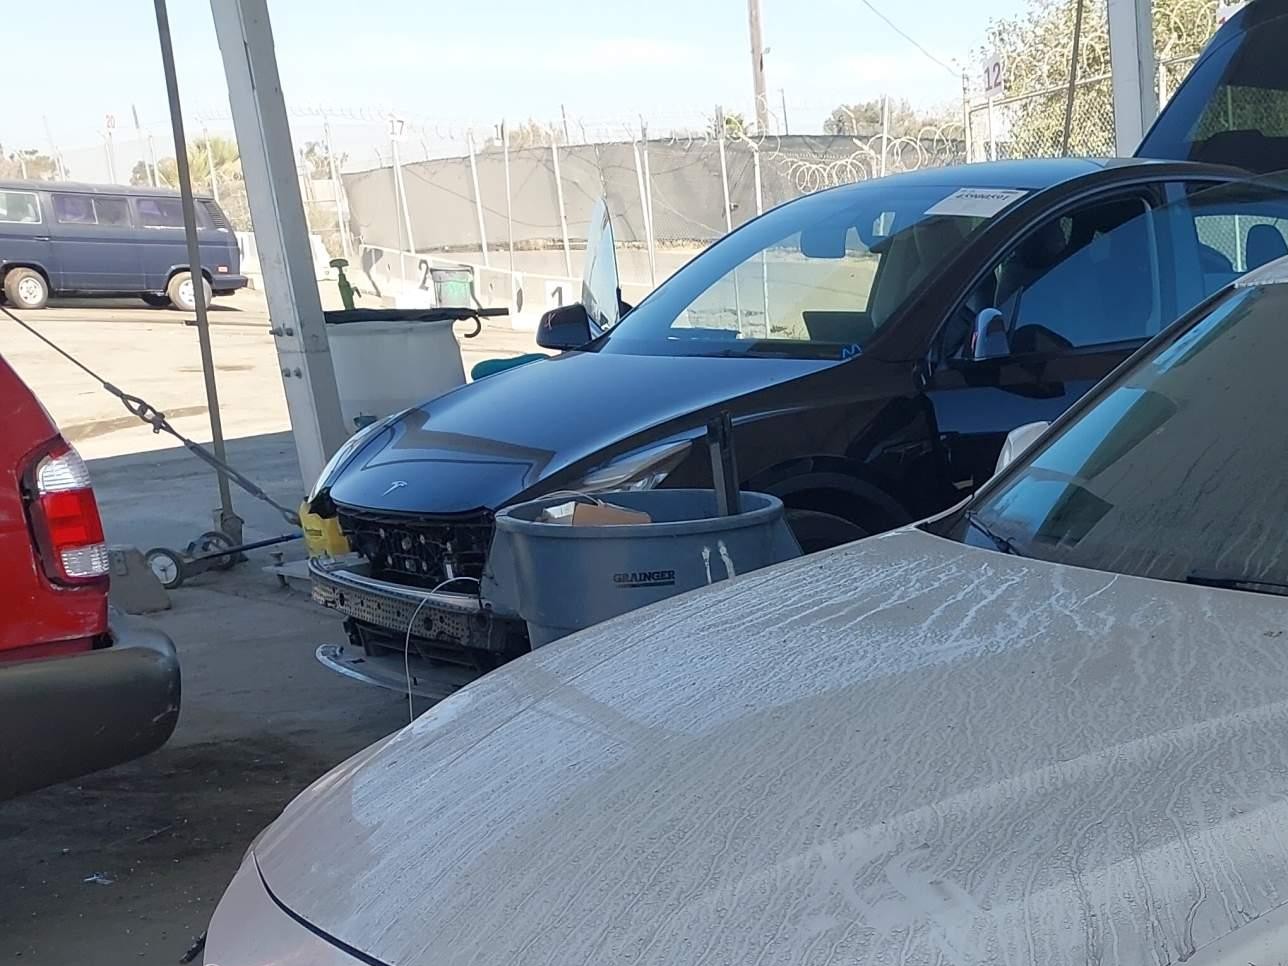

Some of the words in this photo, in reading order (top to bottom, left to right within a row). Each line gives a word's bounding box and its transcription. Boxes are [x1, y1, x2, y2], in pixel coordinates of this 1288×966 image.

[984, 62, 1001, 91] 12
[389, 119, 405, 136] 17
[612, 569, 676, 584] GRAINGER
